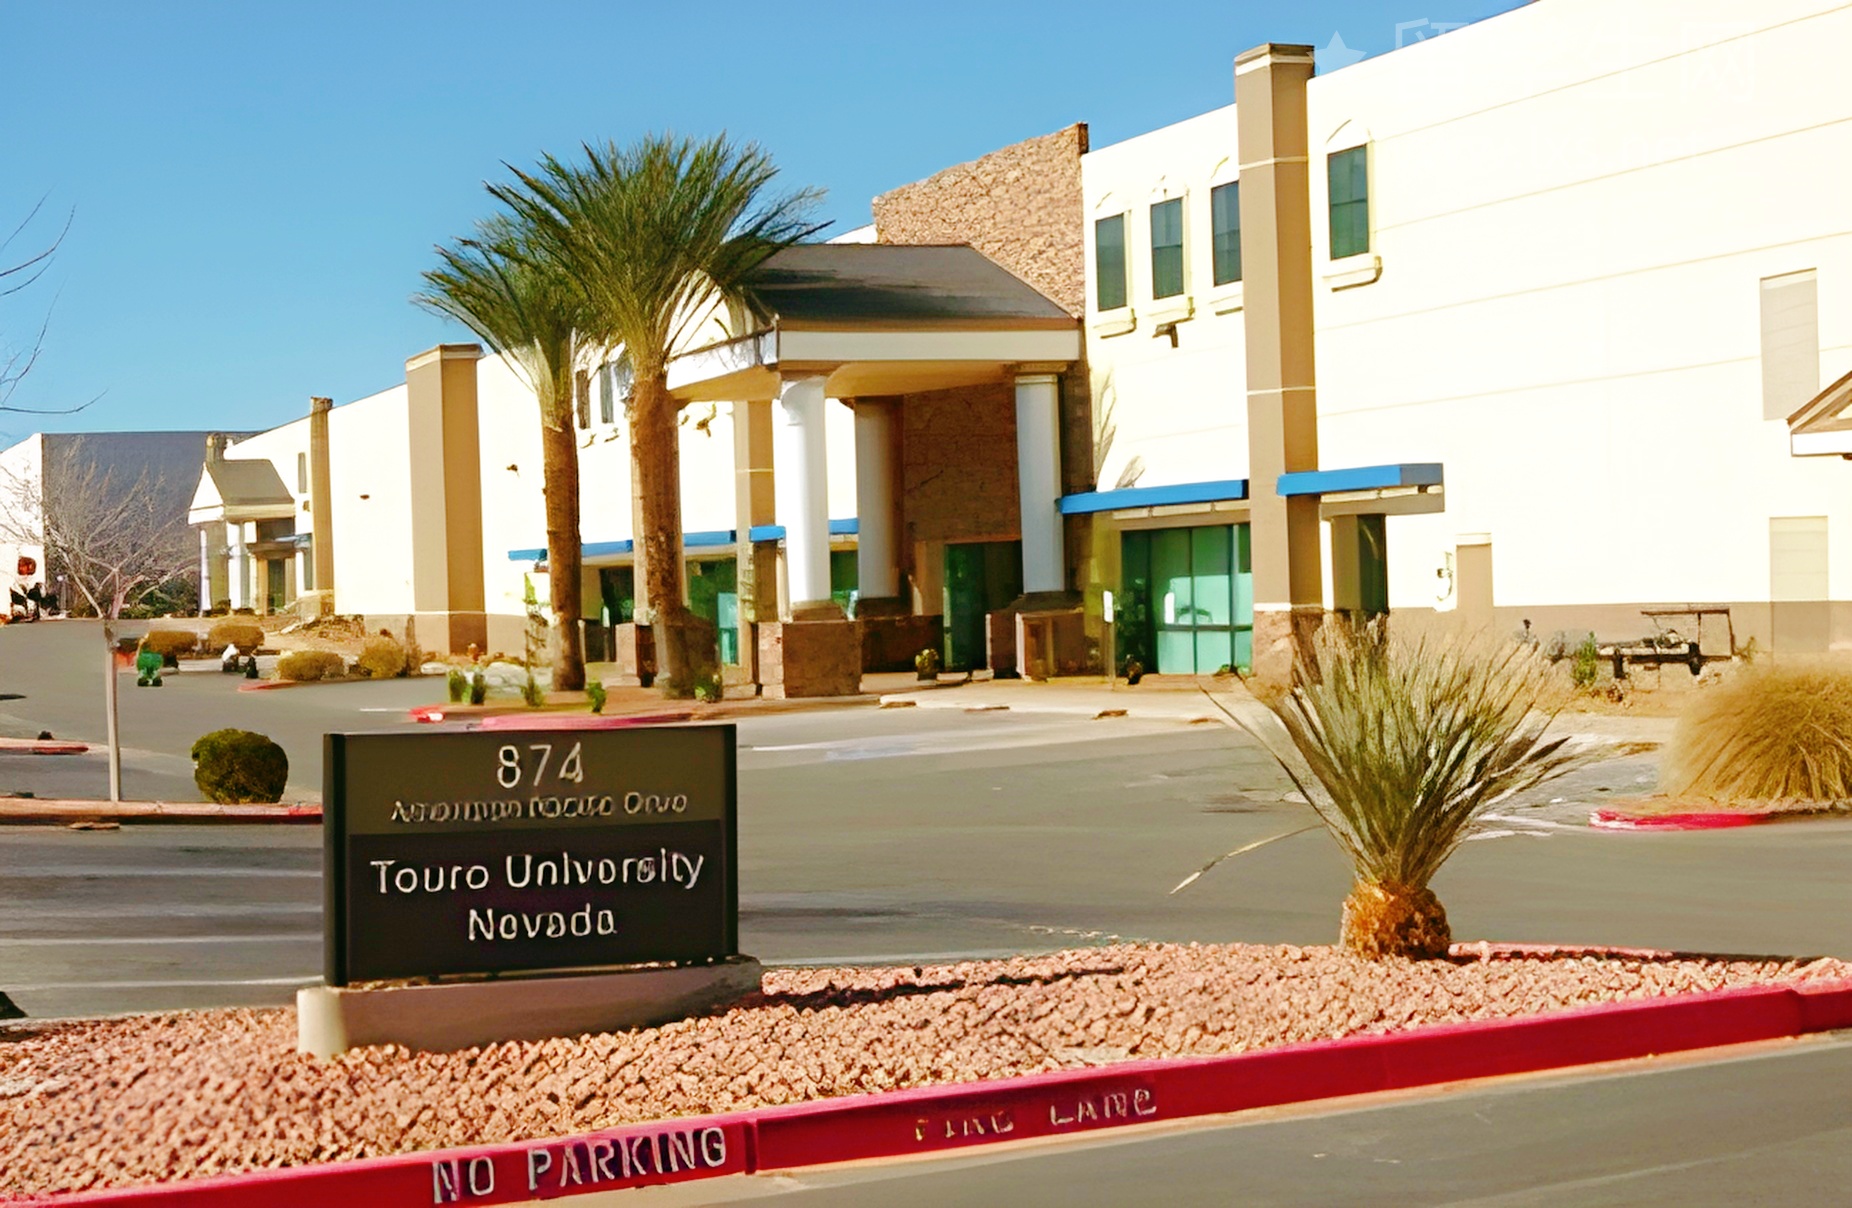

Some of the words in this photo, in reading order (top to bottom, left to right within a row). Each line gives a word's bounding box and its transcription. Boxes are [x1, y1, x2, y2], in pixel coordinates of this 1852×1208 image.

[497, 741, 584, 788] 874
[369, 859, 490, 894] Touro
[432, 1156, 495, 1205] NO
[527, 1126, 727, 1191] PARKING
